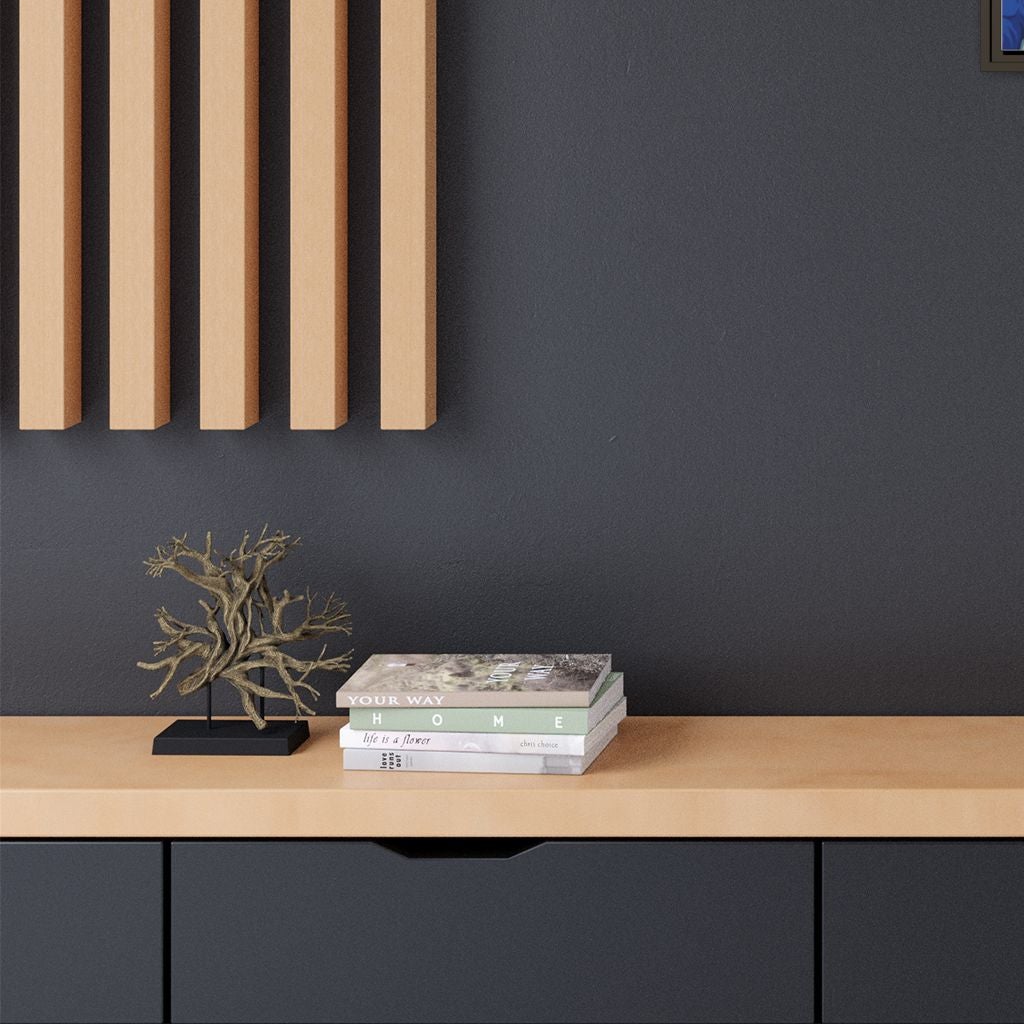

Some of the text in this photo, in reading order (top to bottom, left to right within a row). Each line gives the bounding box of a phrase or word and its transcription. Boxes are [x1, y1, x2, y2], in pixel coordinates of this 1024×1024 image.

[348, 695, 446, 705] YOUR WAY
[363, 732, 431, 747] life is a flower
